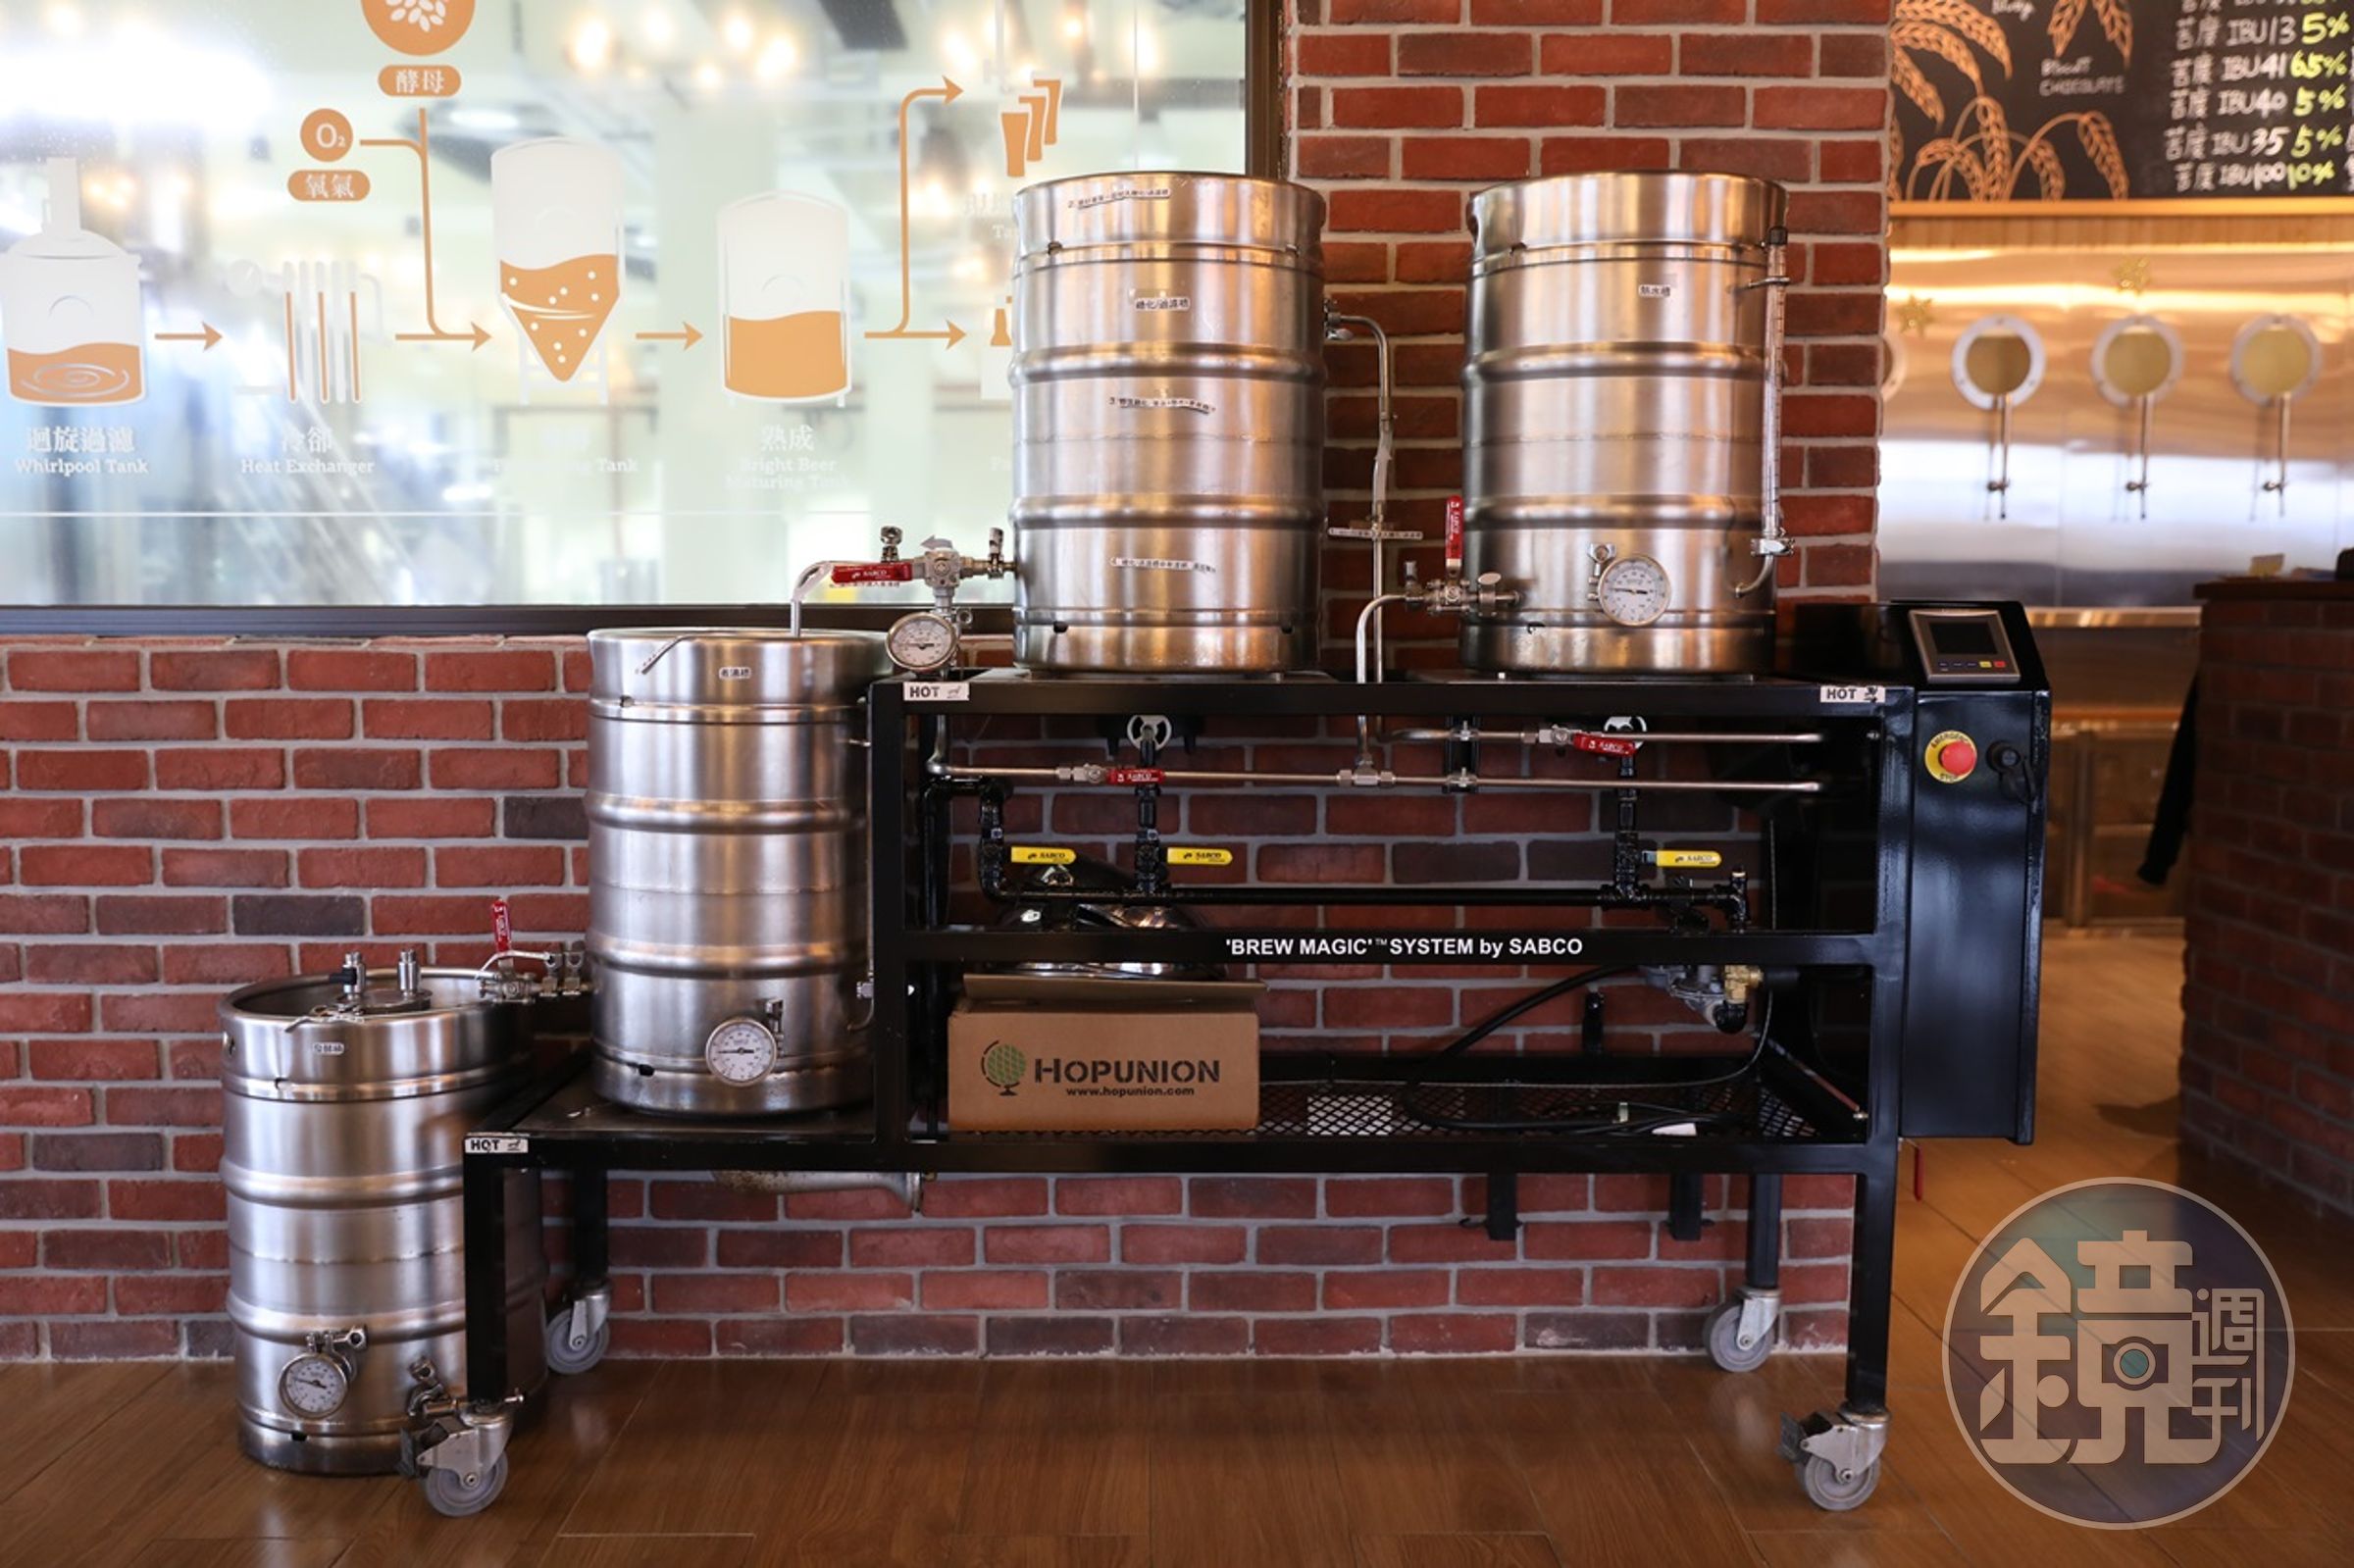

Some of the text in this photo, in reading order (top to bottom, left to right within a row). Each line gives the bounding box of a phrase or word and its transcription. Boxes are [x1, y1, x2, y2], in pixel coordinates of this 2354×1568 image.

[2302, 12, 2350, 44] 5%
[395, 68, 444, 93] 酵母
[2293, 84, 2346, 117] 5%
[2290, 125, 2343, 158] 5%
[306, 174, 354, 198] 氧氣
[28, 426, 135, 453] 迴旋過濾
[761, 424, 815, 451] 熟成
[16, 458, 149, 477] Whirlpool Tank
[241, 458, 375, 478] Heat Exchanger
[797, 456, 838, 473] Beer
[909, 686, 940, 698] HOT
[1826, 688, 1857, 700] HOT
[1389, 938, 1473, 955] SYSTEM
[1479, 938, 1504, 958] by
[1509, 938, 1583, 955] SABCO
[1035, 1058, 1220, 1084] HOPUNION
[1066, 1086, 1195, 1098] www.hopunion.com
[471, 1138, 500, 1151] HOT
